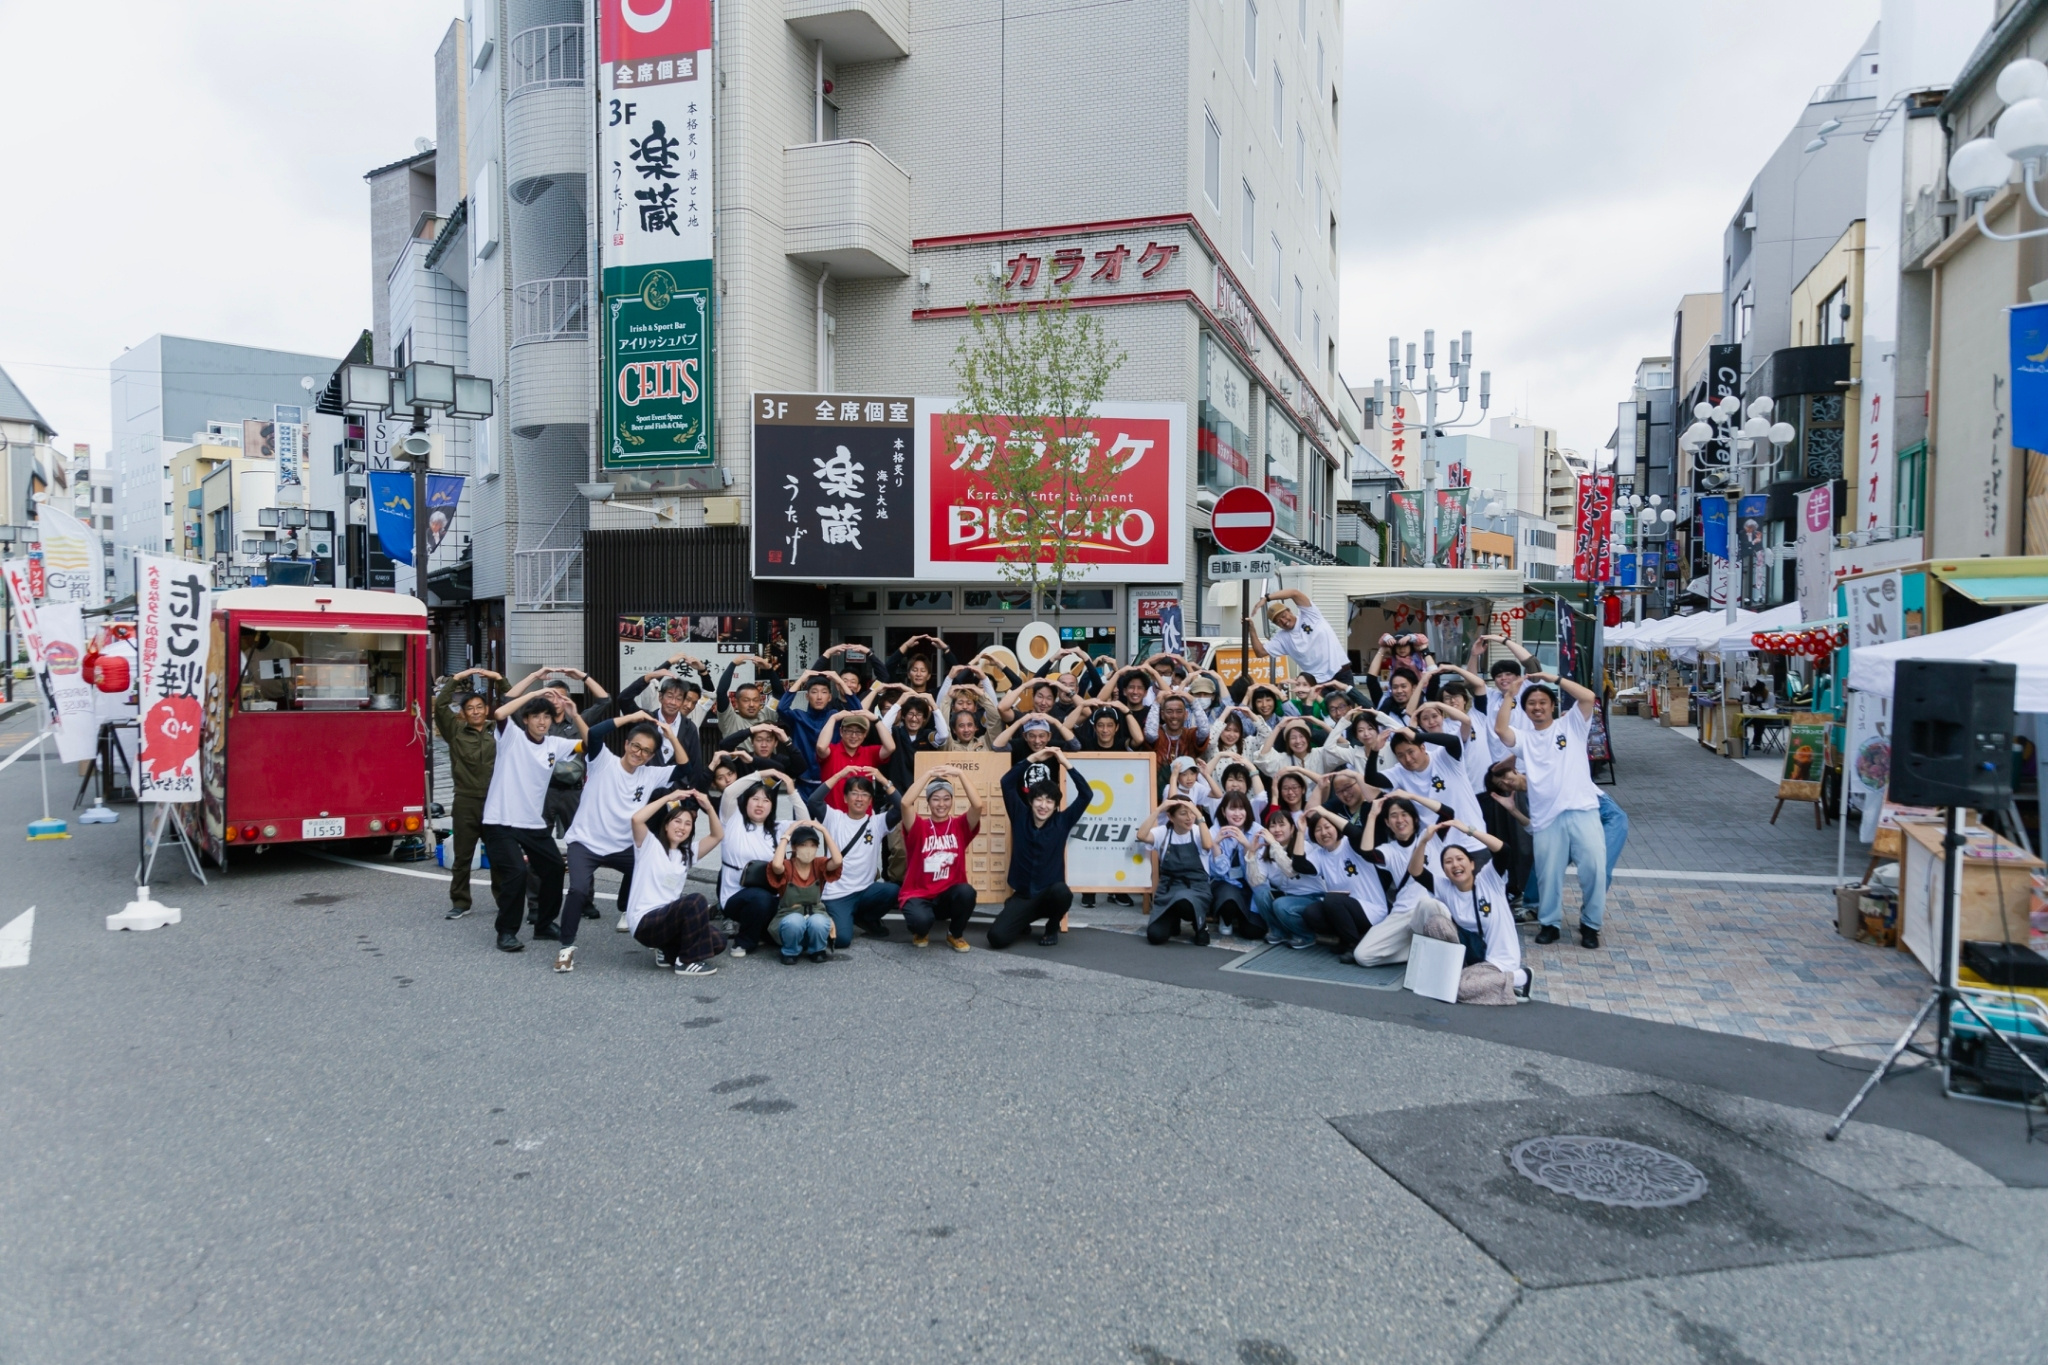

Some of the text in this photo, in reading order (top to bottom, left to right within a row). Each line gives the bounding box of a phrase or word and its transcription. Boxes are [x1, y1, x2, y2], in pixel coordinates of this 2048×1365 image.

[615, 57, 694, 84] 全席個室
[609, 98, 637, 127] 3F
[629, 119, 681, 237] 楽蔵
[1005, 242, 1180, 290] カラオケ
[619, 333, 698, 350] アイリッシュパブ
[630, 324, 647, 333] Irish
[654, 323, 673, 332] Sport
[618, 358, 699, 407] CELTS
[762, 399, 909, 422] 3F 全席個室
[893, 438, 905, 488] 本格炙り
[950, 429, 1155, 474] カラオケ
[813, 445, 865, 550] 楽蔵
[876, 470, 888, 520] 海と大地
[783, 475, 807, 565] うたげ
[949, 505, 1155, 546] BIG ECHO
[624, 644, 635, 655] 3F
[720, 645, 751, 653] 全席個室
[313, 825, 343, 837] 15-53
